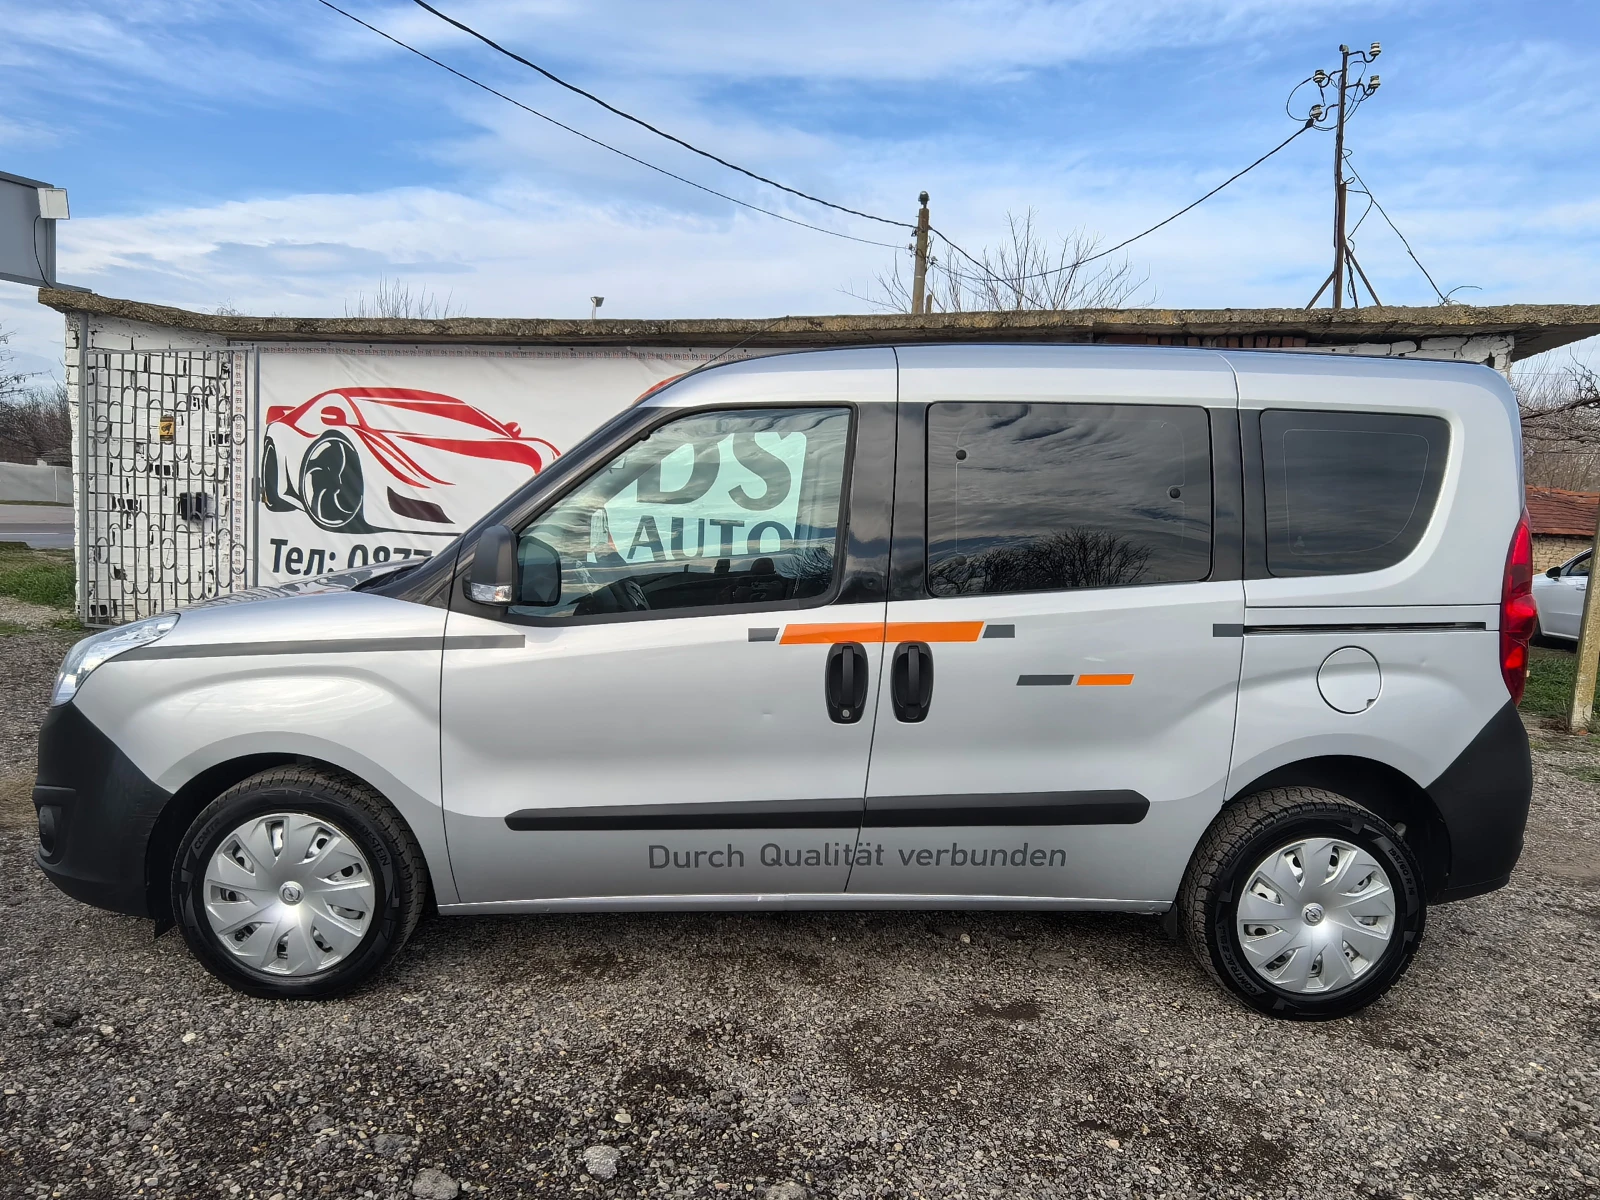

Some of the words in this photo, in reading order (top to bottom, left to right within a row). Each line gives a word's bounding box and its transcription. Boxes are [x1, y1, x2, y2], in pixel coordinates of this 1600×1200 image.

[270, 538, 337, 575] Тел:
[627, 514, 794, 562] AUTO
[648, 843, 745, 869] Durch
[759, 841, 884, 867] Qualität
[898, 842, 1067, 867] verbunden
